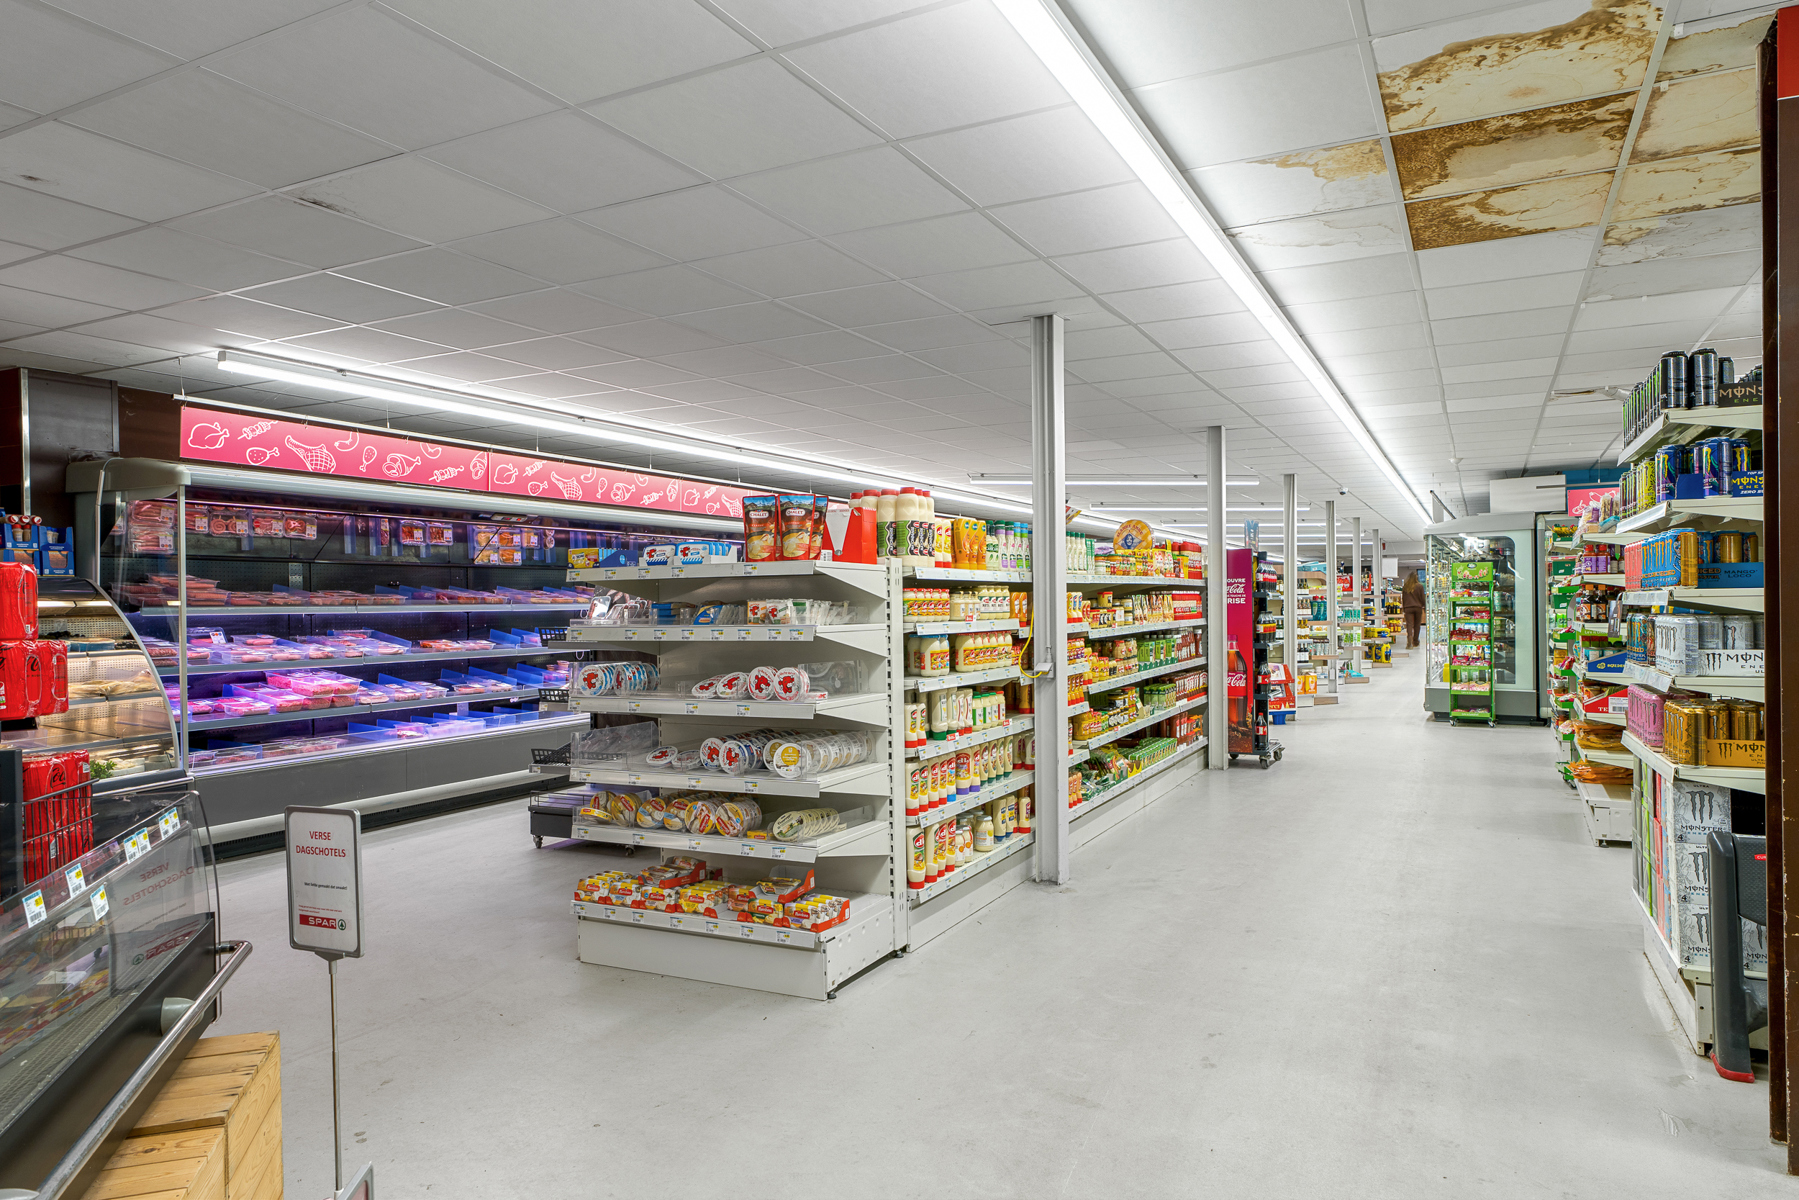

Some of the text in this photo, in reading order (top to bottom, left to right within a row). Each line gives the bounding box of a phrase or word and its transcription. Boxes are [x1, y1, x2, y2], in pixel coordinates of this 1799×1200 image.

[1719, 385, 1763, 399] MONS
[1732, 476, 1763, 486] MONS
[1726, 652, 1764, 662] MON
[1736, 742, 1765, 752] MON
[309, 831, 331, 840] VERSE
[296, 845, 346, 857] DAGSCHOTELS
[308, 917, 336, 927] SPAR
